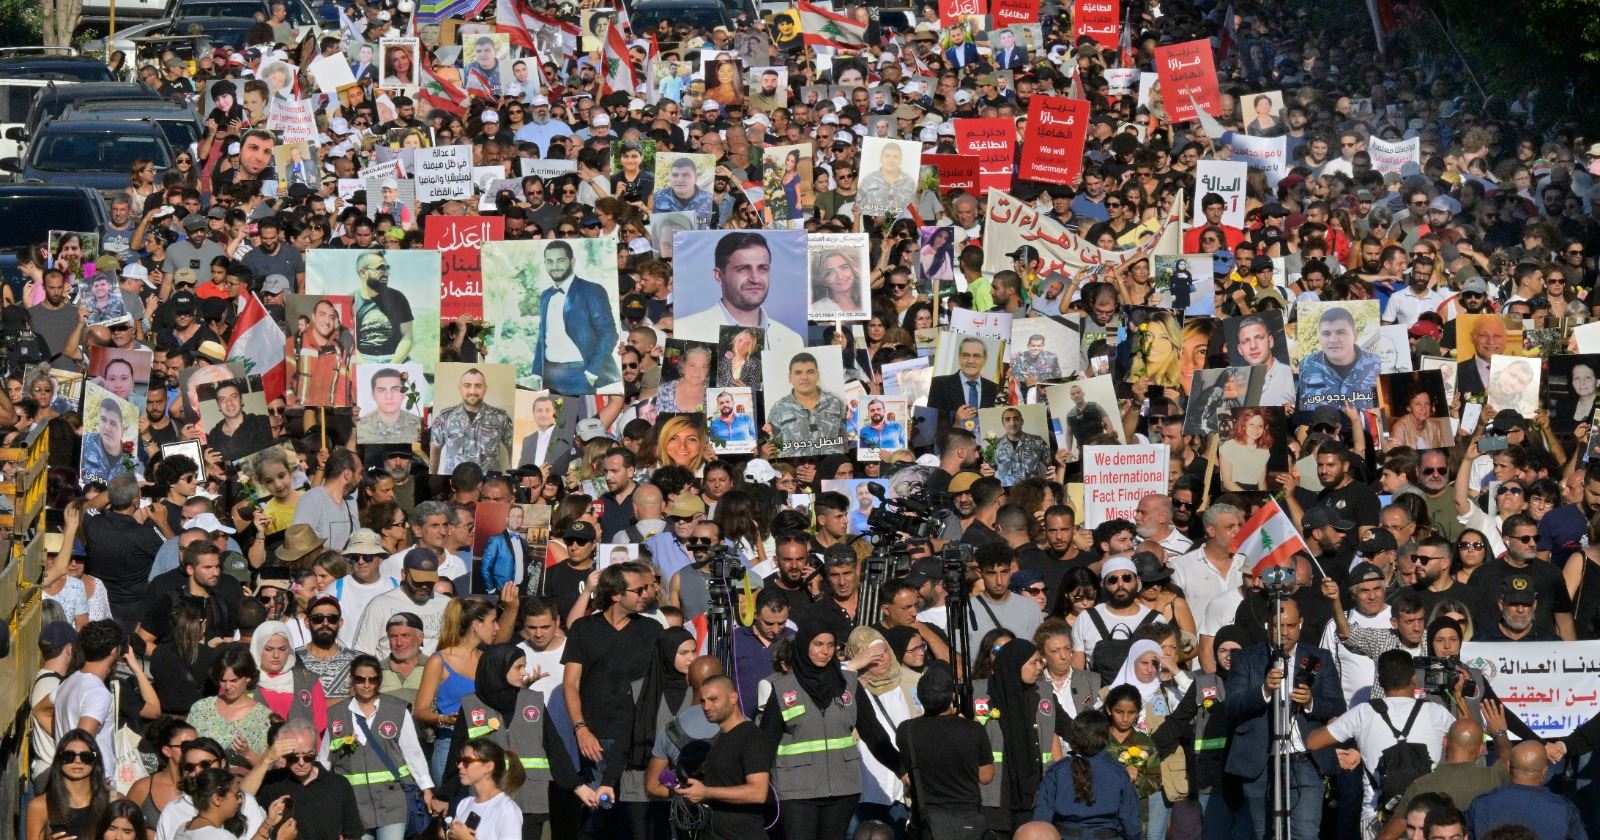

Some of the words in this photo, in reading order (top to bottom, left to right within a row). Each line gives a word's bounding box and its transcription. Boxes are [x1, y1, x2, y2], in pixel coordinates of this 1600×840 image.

[1078, 23, 1116, 34] العدل
[433, 149, 449, 157] عدالة
[451, 148, 456, 156] لا
[1040, 145, 1051, 154] We
[423, 161, 443, 170] هيمنة
[445, 160, 455, 170] ظل
[458, 160, 467, 171] في
[1031, 162, 1068, 174] Indictment
[419, 175, 444, 185] والمافيا
[939, 180, 974, 188] الصم
[1201, 174, 1241, 192] العدالة
[430, 187, 451, 197] القضاء
[453, 187, 464, 197] على
[1307, 393, 1325, 404] نون
[1327, 394, 1346, 404] دجو
[793, 440, 813, 450] دجو
[814, 437, 844, 449] البطل
[1095, 452, 1111, 466] We
[1113, 451, 1156, 466] demand
[1084, 474, 1097, 485] an
[1100, 468, 1165, 484] International
[1092, 489, 1115, 503] Fact
[1499, 656, 1557, 674] العدالة
